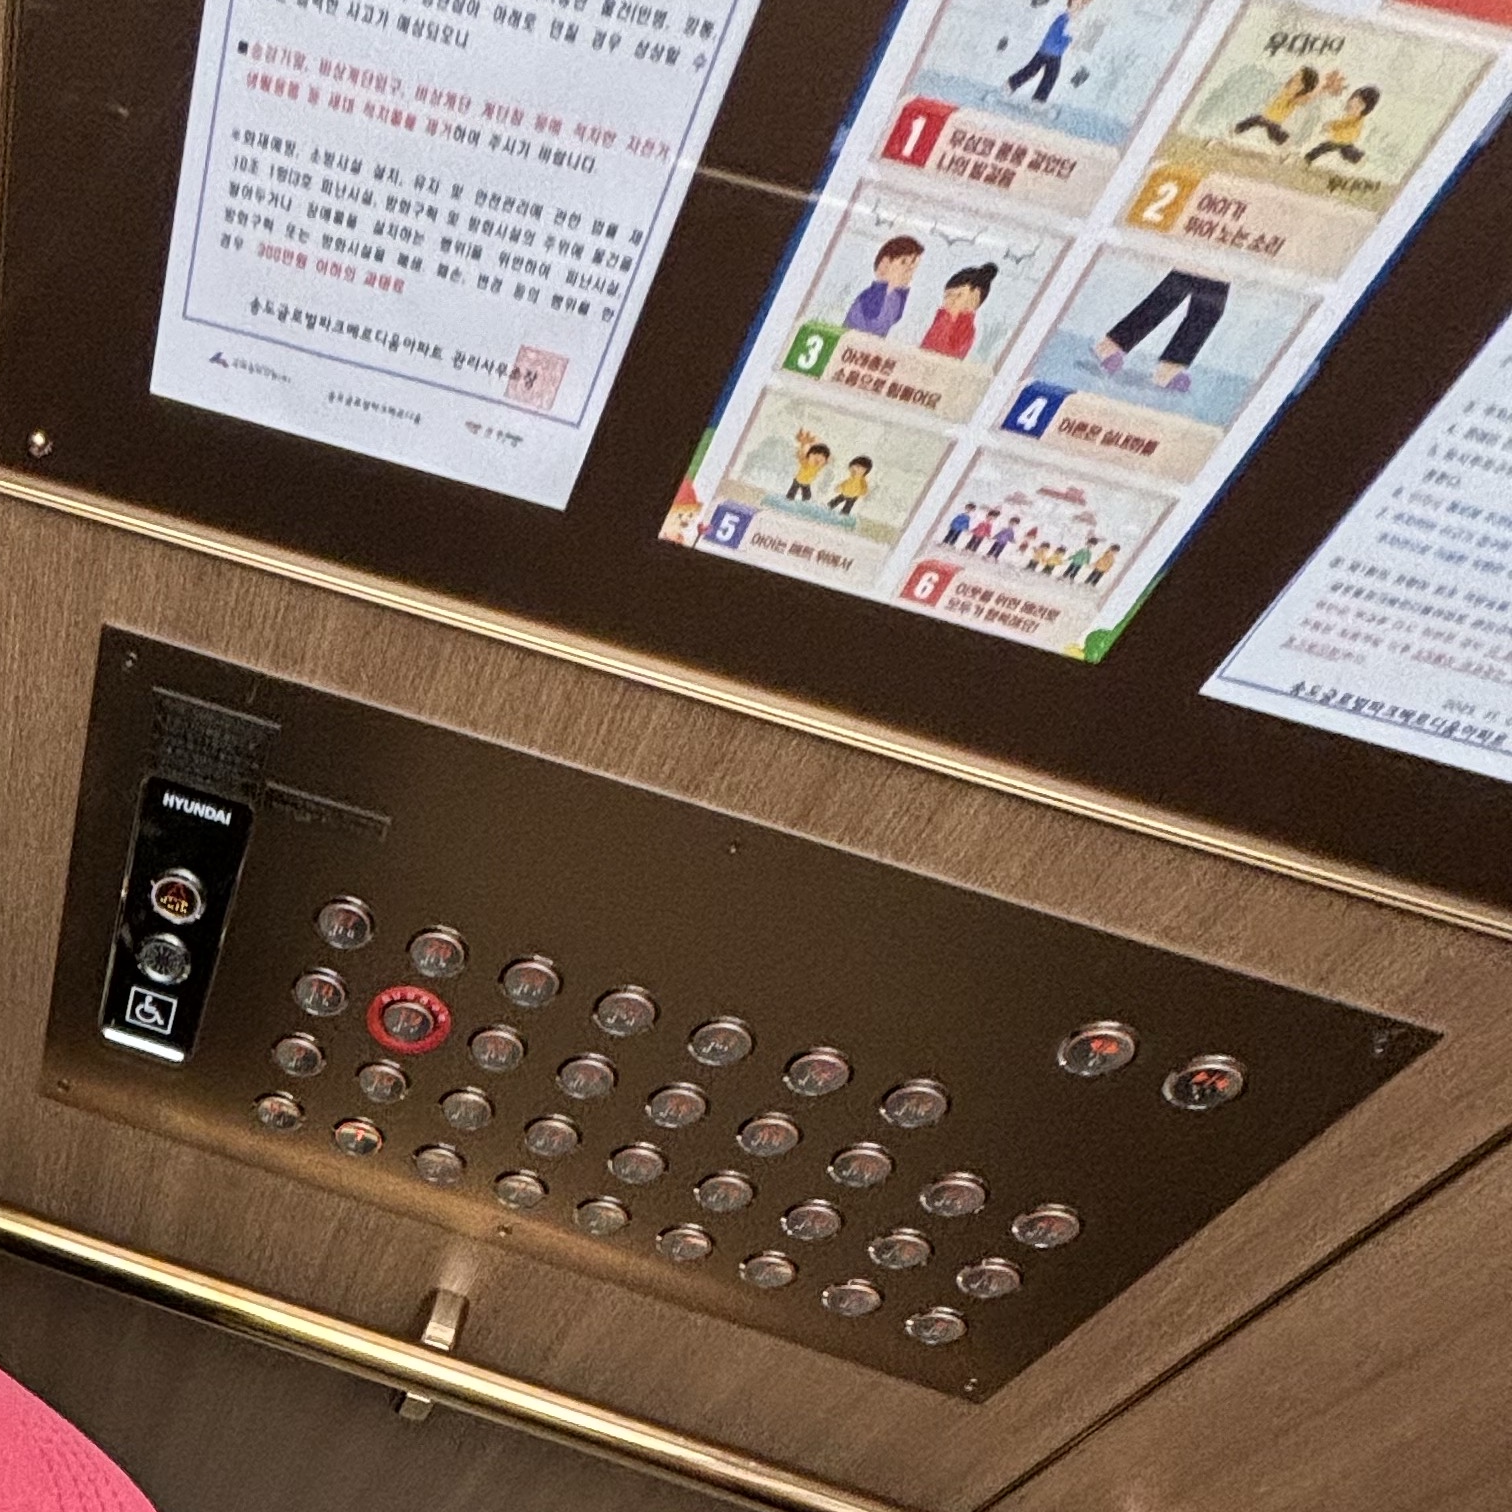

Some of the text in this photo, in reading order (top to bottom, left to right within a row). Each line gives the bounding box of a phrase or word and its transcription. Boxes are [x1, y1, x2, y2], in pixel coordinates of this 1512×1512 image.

[901, 116, 926, 157] 1
[937, 151, 970, 177] 나의
[1142, 181, 1179, 223] 2
[1196, 193, 1248, 221] 아이가
[1247, 232, 1286, 259] 소리
[797, 334, 824, 370] 3
[1016, 397, 1048, 431] 4
[715, 511, 740, 542] 5
[913, 571, 939, 600] 6
[162, 790, 232, 827] HYUNDAI
